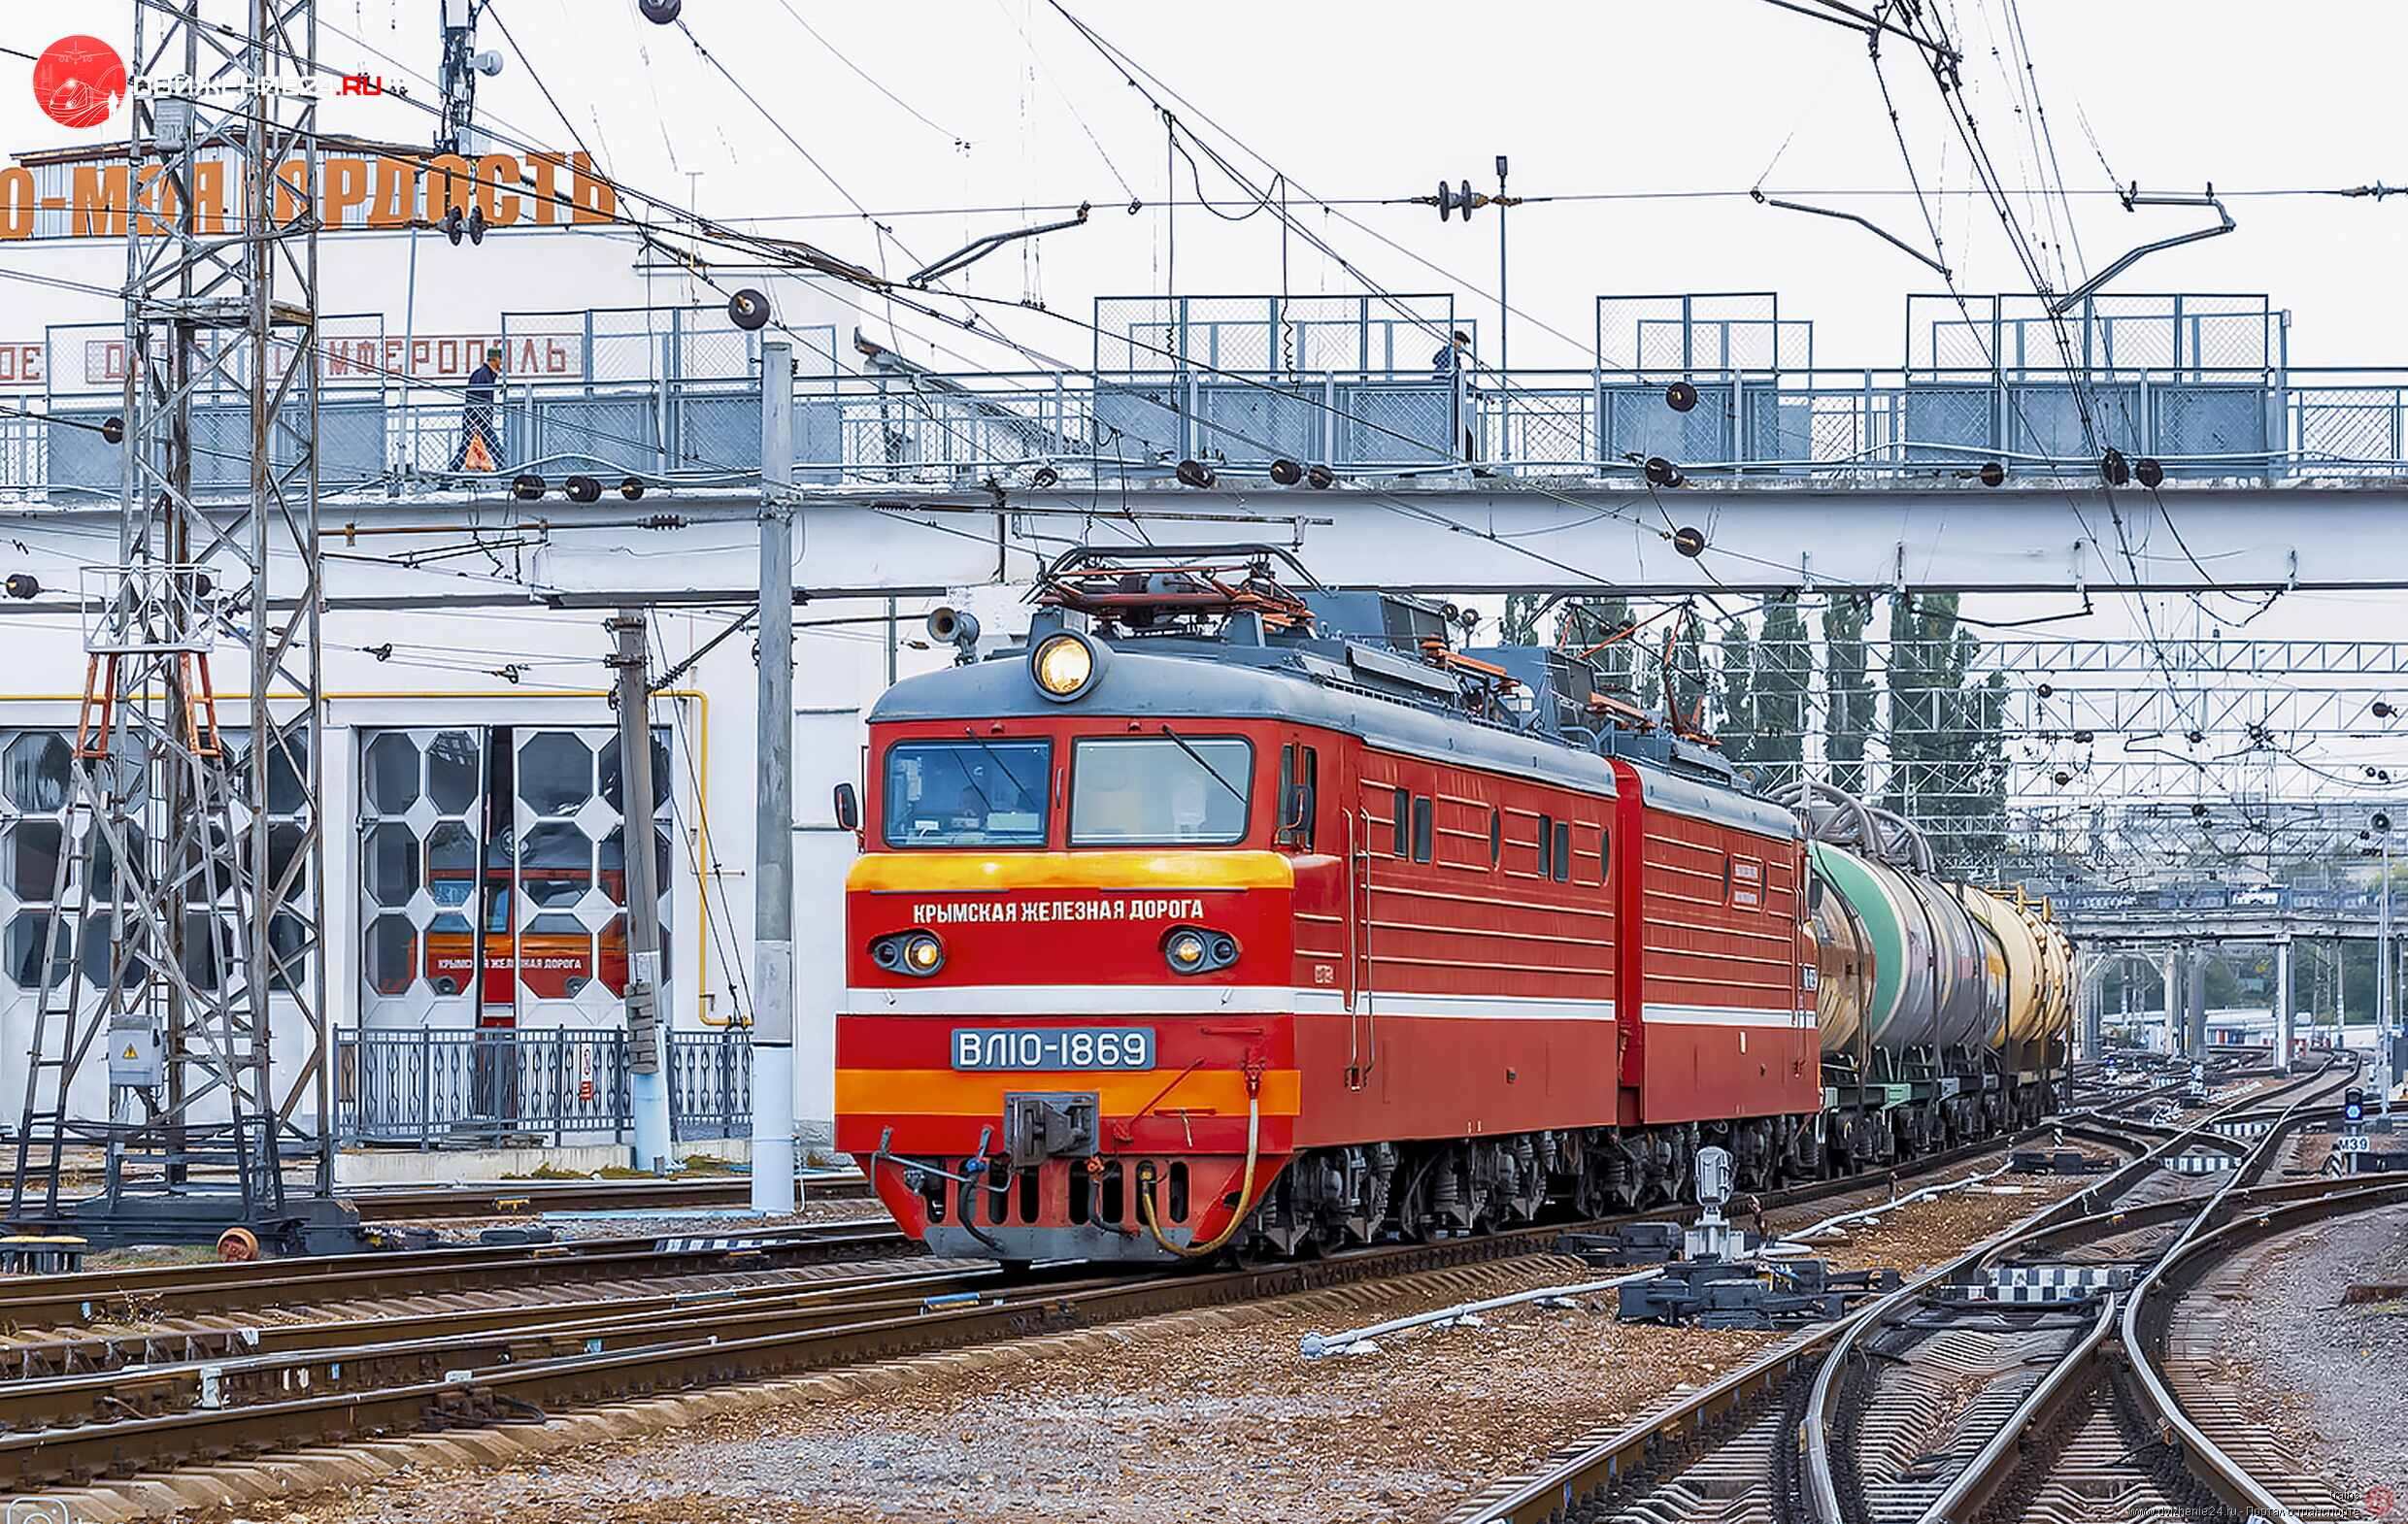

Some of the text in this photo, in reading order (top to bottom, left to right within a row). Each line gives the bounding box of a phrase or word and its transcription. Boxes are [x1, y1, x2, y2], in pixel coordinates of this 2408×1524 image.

[913, 899, 1204, 924] КРЫМСКАЯ ЖЕЛЕЗНАЯ ДОРОГА
[544, 958, 583, 969] ДОРОГА
[958, 1032, 1147, 1066] ВЛ10-1869
